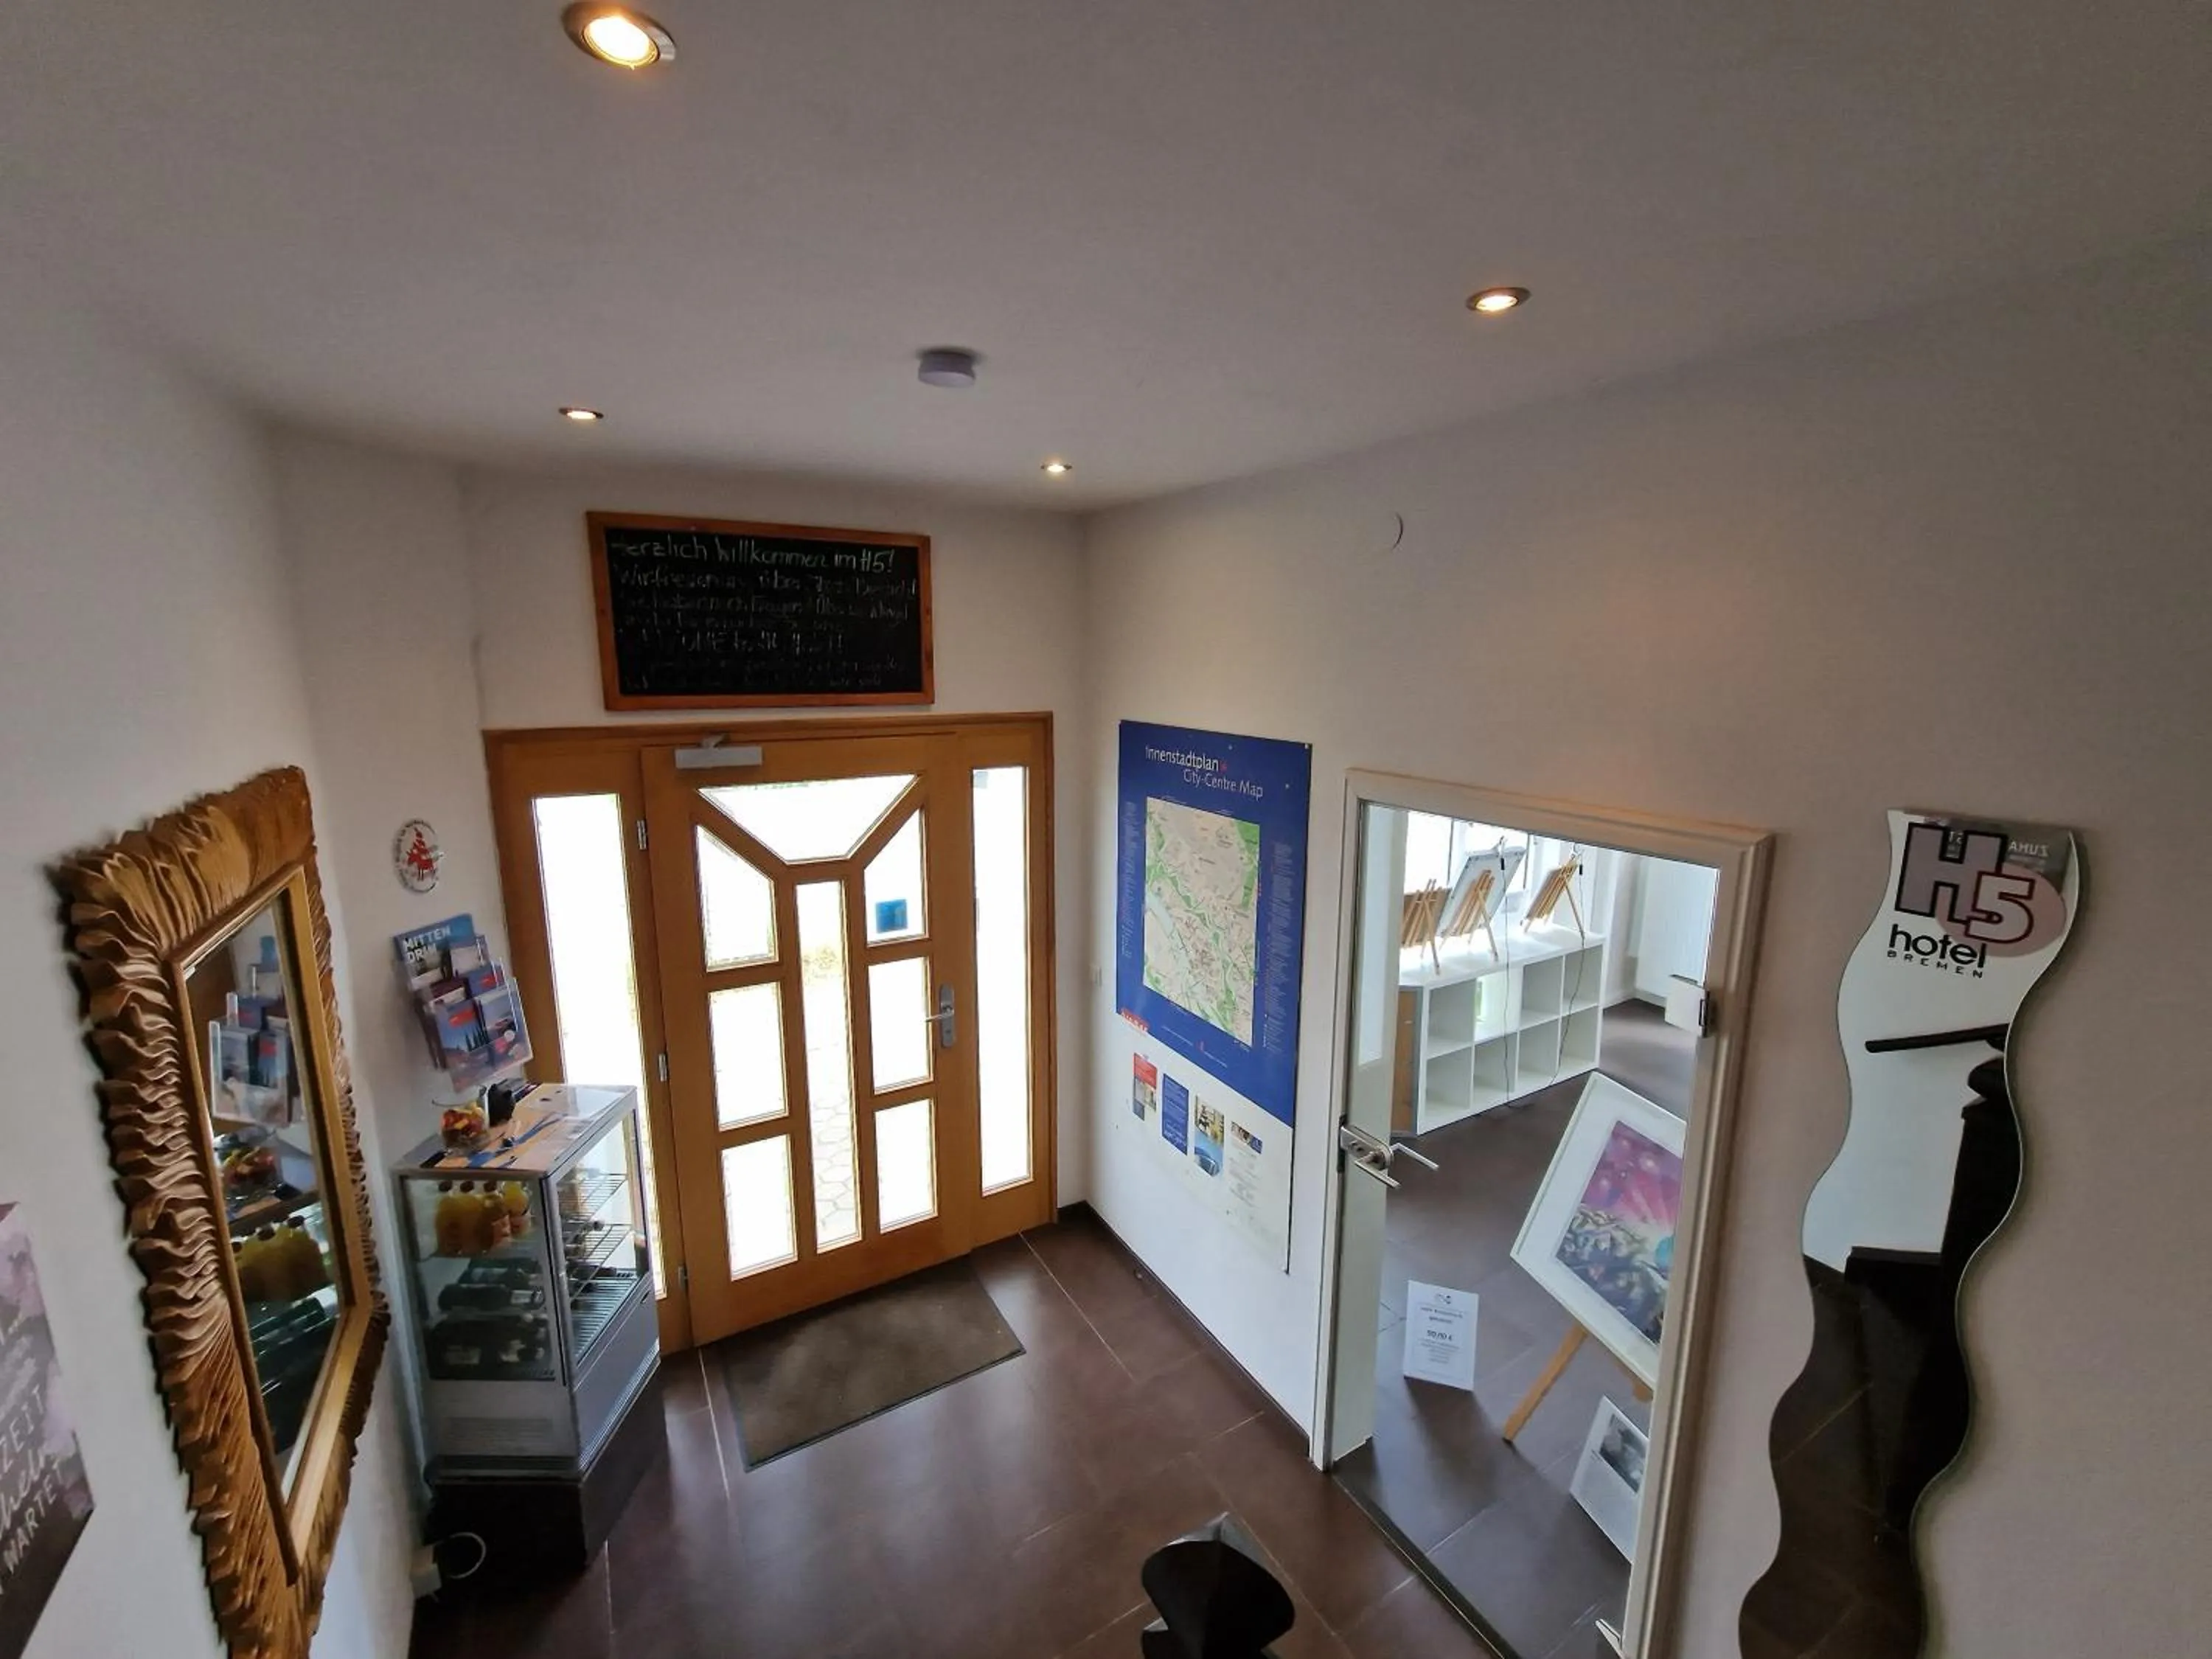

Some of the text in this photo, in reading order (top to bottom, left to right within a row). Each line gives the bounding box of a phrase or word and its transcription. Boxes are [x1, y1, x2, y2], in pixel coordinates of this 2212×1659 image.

[834, 552, 857, 570] im
[1145, 745, 1220, 772] Innenstadtplan
[1183, 768, 1263, 801] City-Centre Map
[1894, 822, 2036, 944] H5
[402, 924, 451, 949] MITTEN
[1888, 923, 1986, 969] hotel
[1887, 950, 1983, 978] BREMEN
